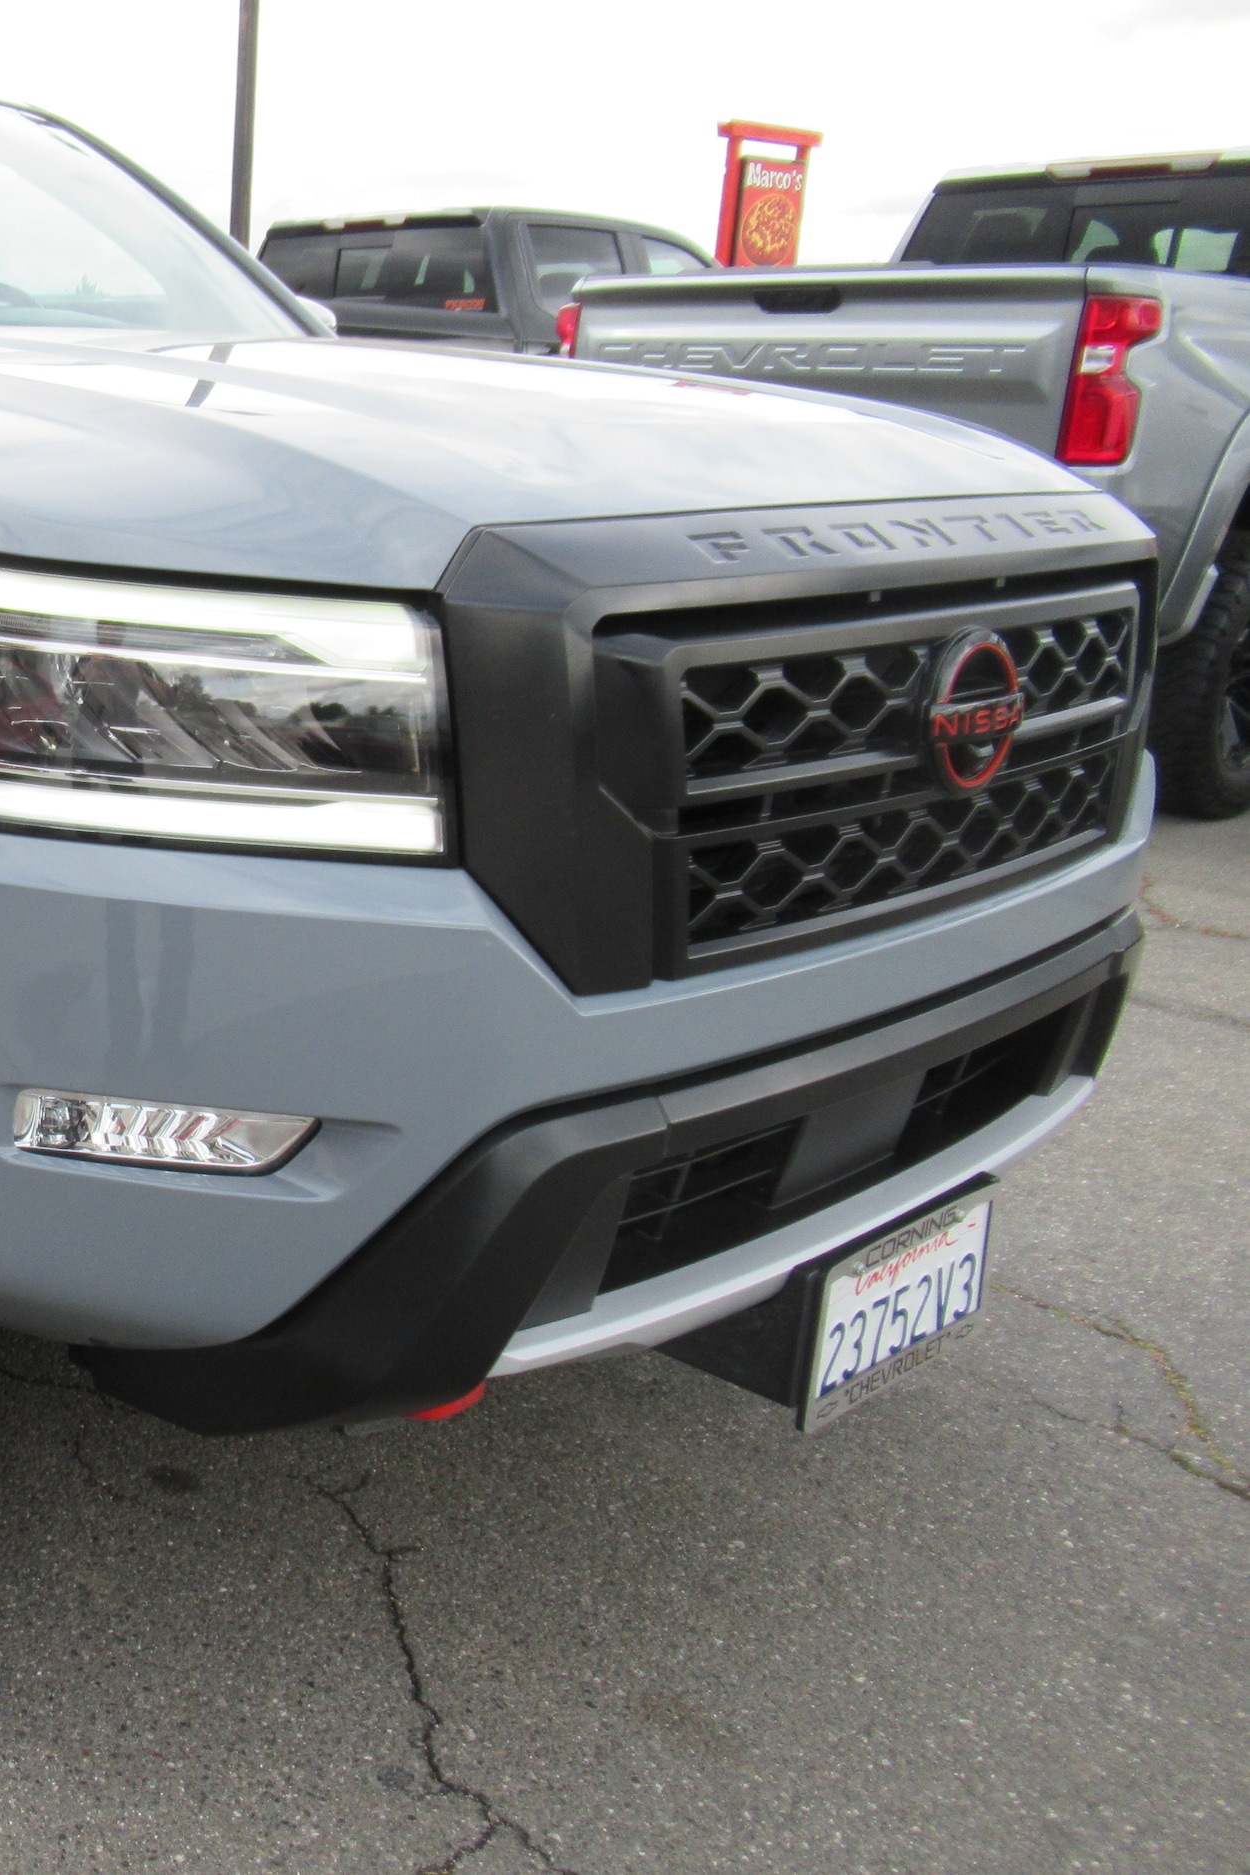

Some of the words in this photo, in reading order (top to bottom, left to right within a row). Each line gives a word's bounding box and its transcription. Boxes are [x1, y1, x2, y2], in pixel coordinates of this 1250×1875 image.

[747, 162, 803, 191] Marco's
[597, 342, 1027, 373] CHEVROLET
[687, 509, 1107, 564] FRONTIER
[855, 1231, 959, 1296] California
[865, 1205, 959, 1268] CORNING
[819, 1252, 976, 1398] 23752V3
